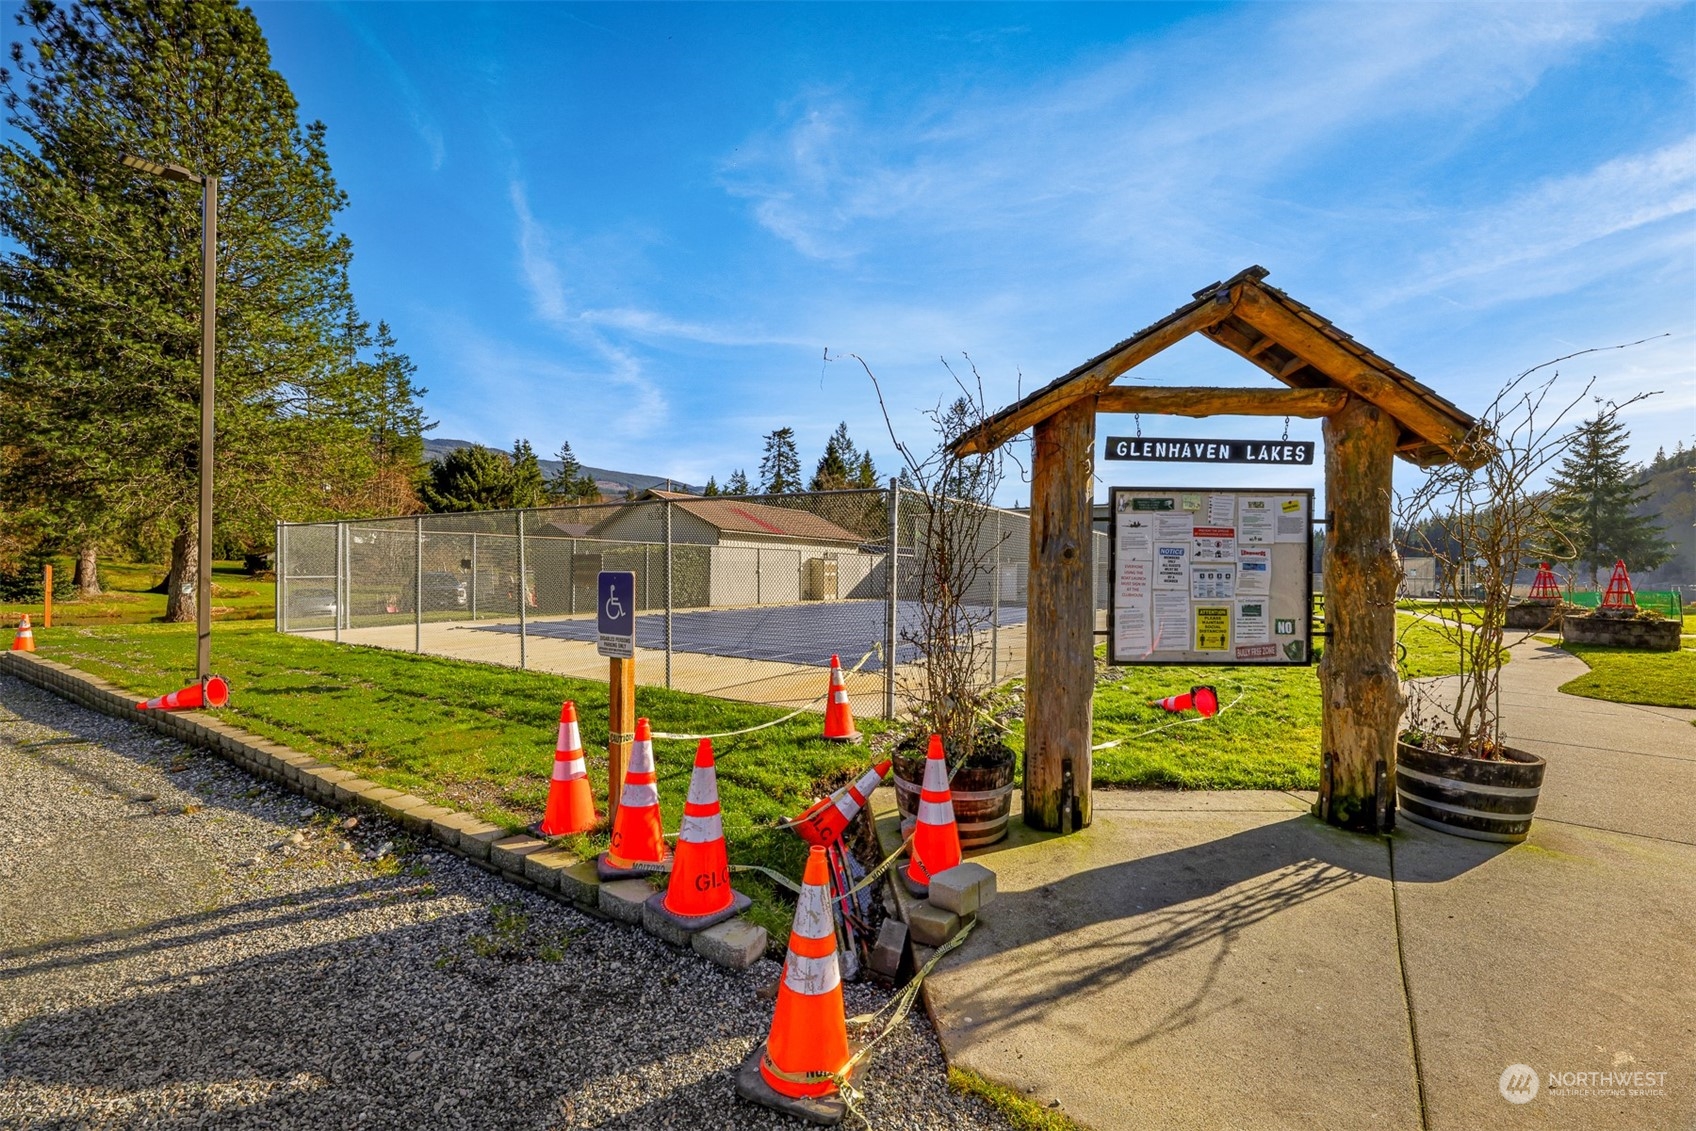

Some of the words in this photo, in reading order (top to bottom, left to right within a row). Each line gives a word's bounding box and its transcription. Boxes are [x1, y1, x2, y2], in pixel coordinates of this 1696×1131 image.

[1116, 442, 1230, 460] GLENHAVEN
[1247, 446, 1305, 461] LAKES
[1278, 621, 1292, 633] NO
[1237, 648, 1250, 657] BULLY
[1262, 646, 1275, 654] ZONE
